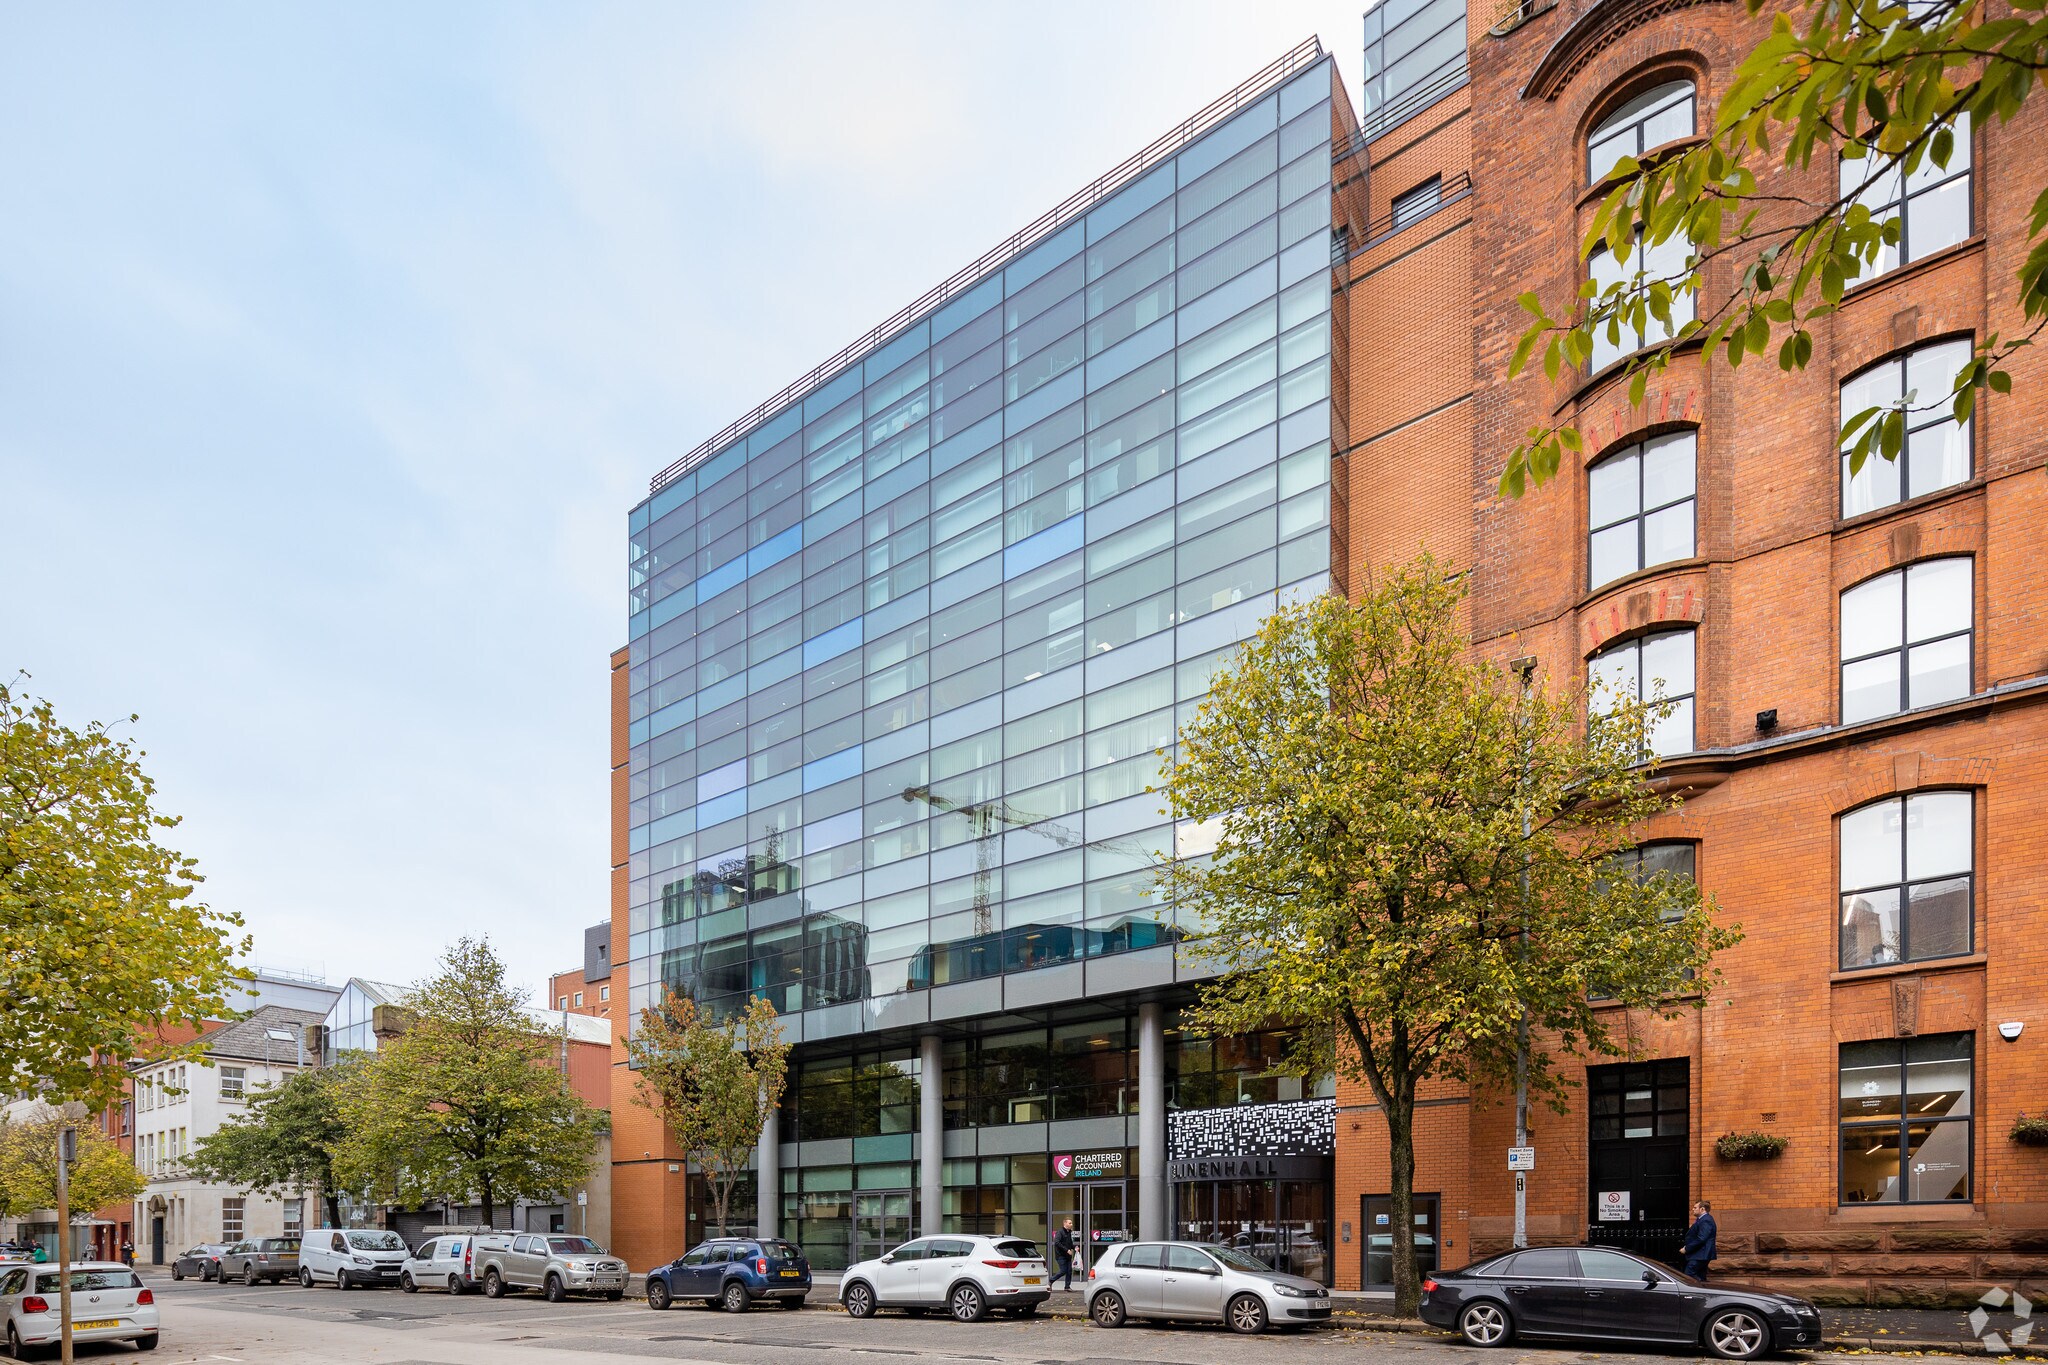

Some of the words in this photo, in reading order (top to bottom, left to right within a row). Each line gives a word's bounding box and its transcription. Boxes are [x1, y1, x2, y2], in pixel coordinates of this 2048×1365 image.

[1075, 1153, 1122, 1163] CHARTERED
[1075, 1161, 1122, 1170] ACCOUNTANTS
[1175, 1160, 1278, 1178] LINENHALL
[1075, 1169, 1102, 1177] IRELAND
